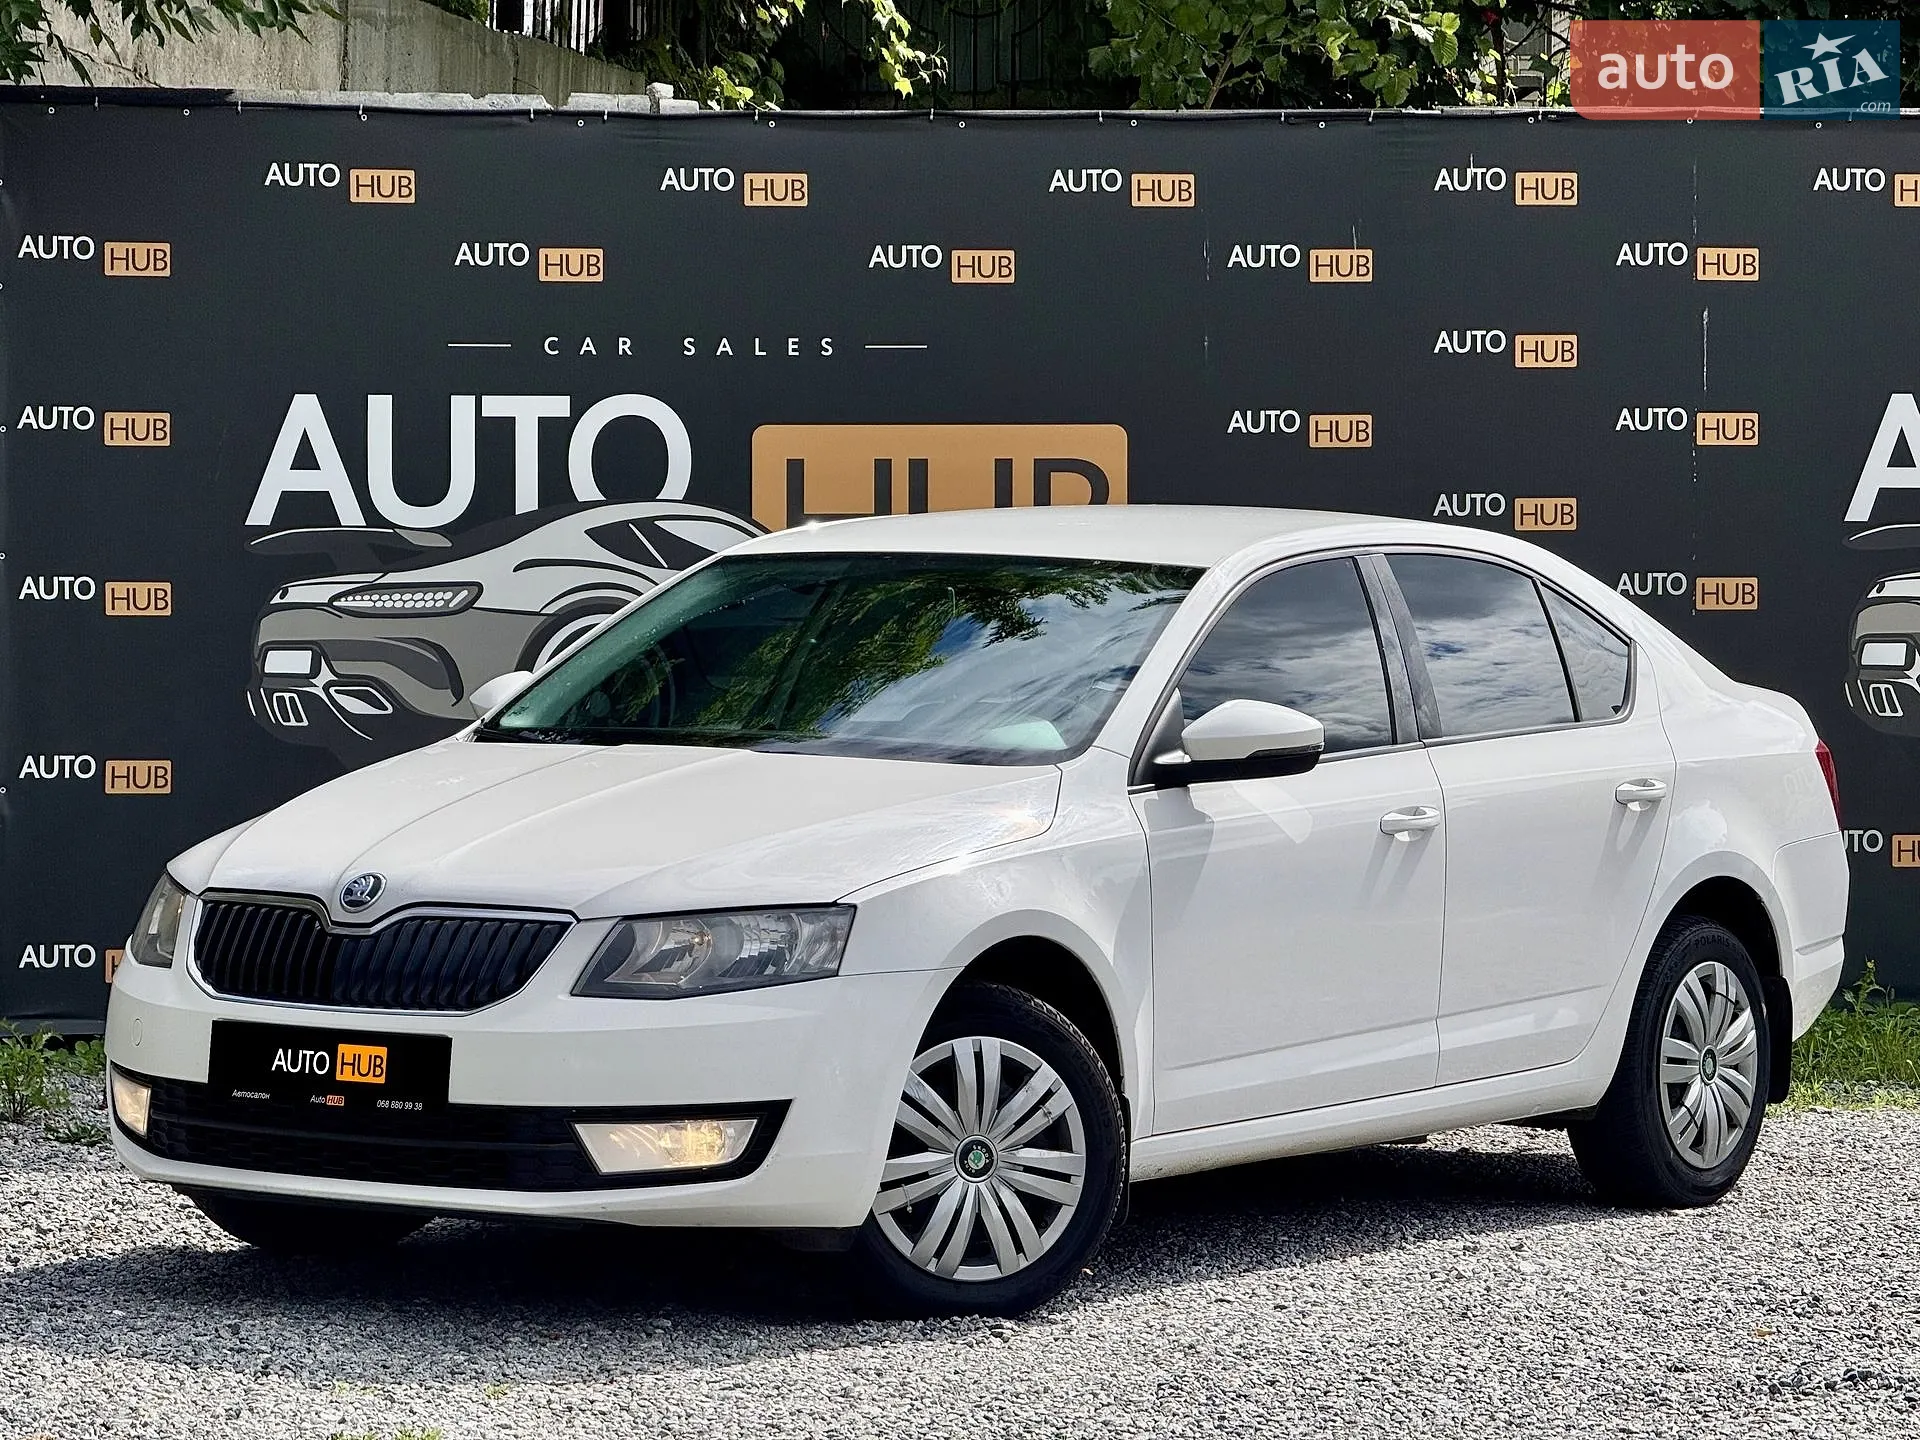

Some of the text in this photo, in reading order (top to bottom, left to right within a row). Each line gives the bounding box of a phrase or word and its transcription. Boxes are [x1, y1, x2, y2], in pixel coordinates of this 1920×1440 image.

[265, 163, 411, 198] AUTO HUB
[660, 168, 804, 201] AUTO HUB
[1049, 169, 1191, 202] AUTO HUB
[1434, 168, 1574, 200] AUTO HUB
[1813, 168, 1885, 191] AUTO
[18, 235, 167, 271] AUTO HUB
[455, 243, 600, 276] AUTO HUB
[869, 245, 1012, 278] AUTO HUB
[1227, 244, 1369, 277] AUTO HUB
[1616, 242, 1756, 275] AUTO HUB
[544, 337, 833, 356] CAR SALES
[1434, 330, 1574, 362] AUTO HUB
[17, 406, 167, 441] AUTO HUB
[1227, 410, 1369, 442] AUTO HUB
[1616, 407, 1756, 440] AUTO HUB
[245, 393, 692, 529] AUTO
[1433, 493, 1573, 526] AUTO HUB
[19, 576, 167, 611] AUTO HUB
[1617, 573, 1756, 605] AUTO HUB
[19, 755, 167, 789] AUTO HUB
[19, 944, 95, 968] AUTO
[272, 1049, 384, 1077] AUTO HUB
[231, 1089, 270, 1099] Автосалон
[310, 1095, 343, 1105] Auto HUB
[377, 1100, 389, 1108] 068
[414, 1102, 422, 1110] 38
